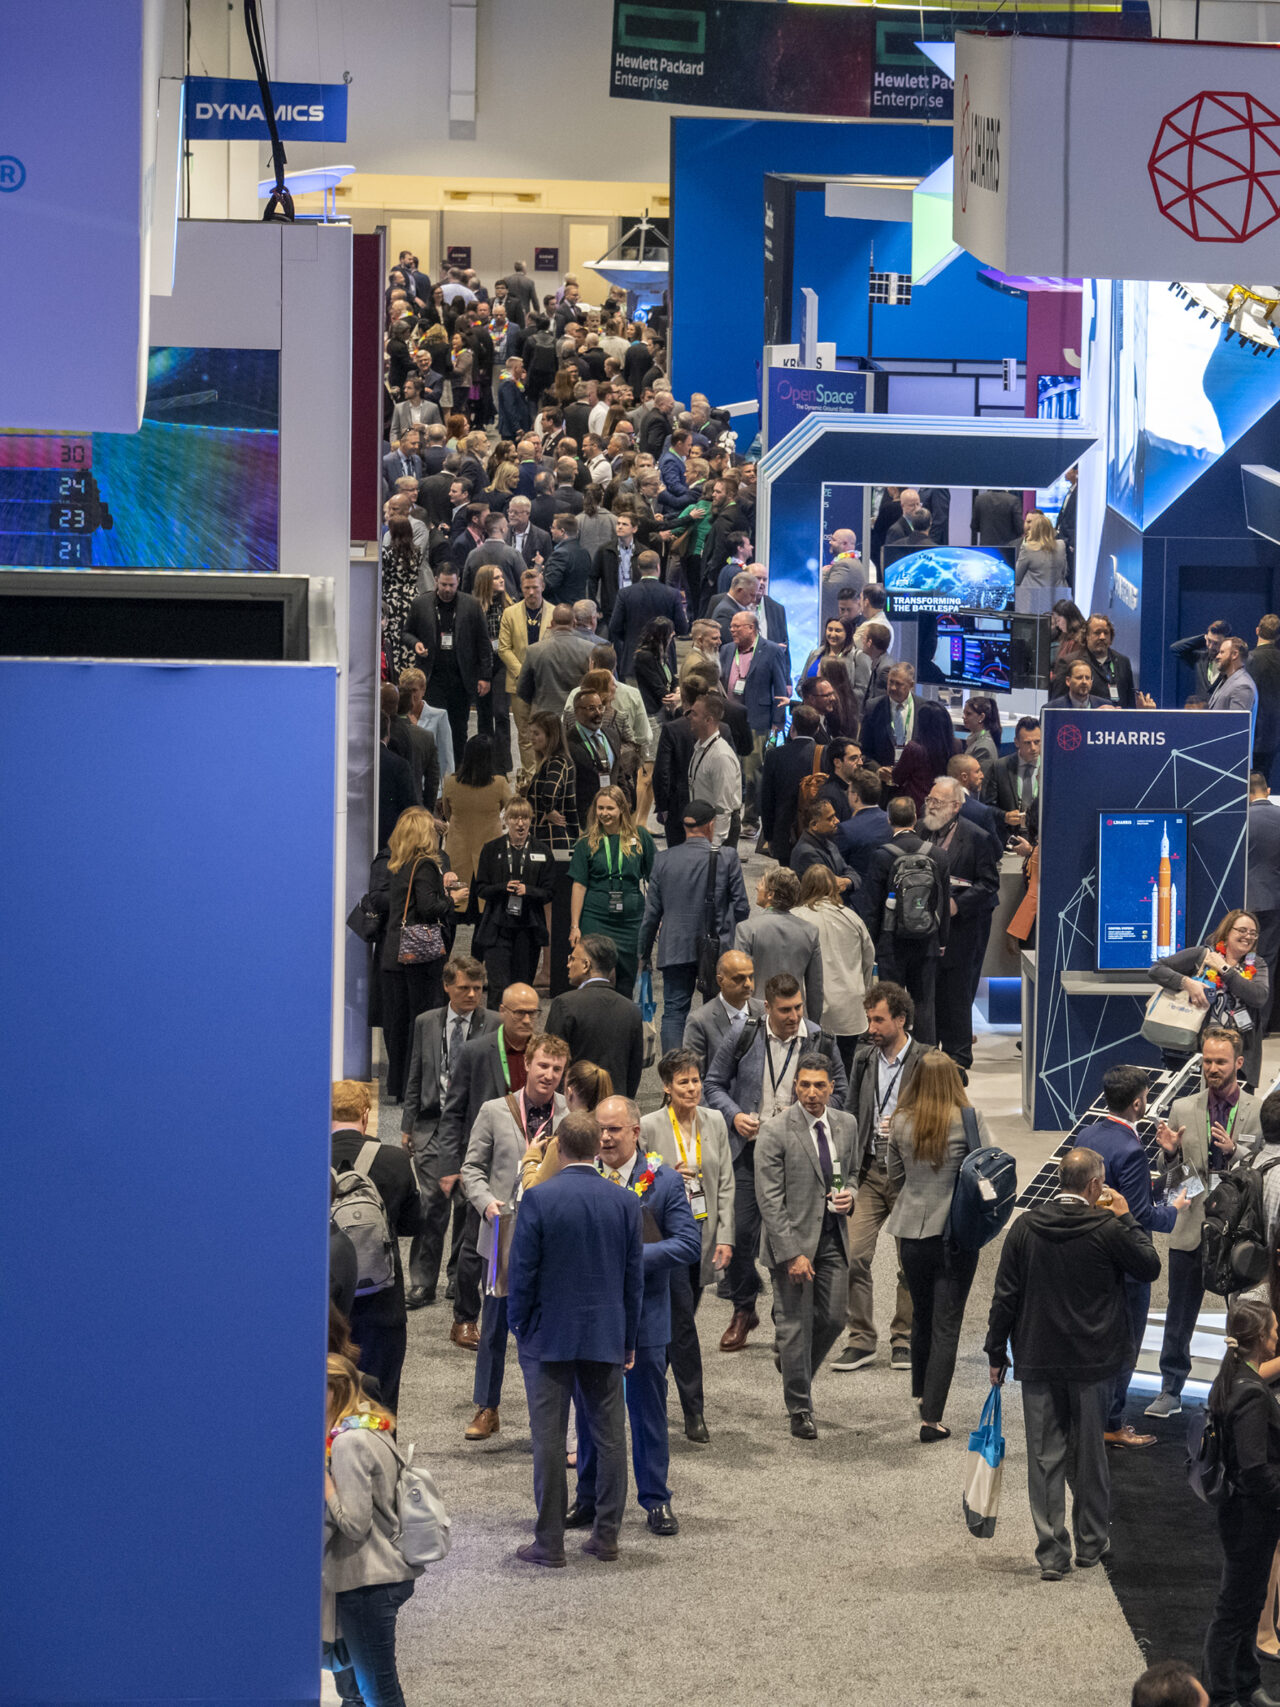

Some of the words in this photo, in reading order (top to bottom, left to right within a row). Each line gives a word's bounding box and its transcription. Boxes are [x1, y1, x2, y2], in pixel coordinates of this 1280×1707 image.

[615, 53, 659, 72] Hewlett
[660, 60, 705, 76] Packard
[614, 71, 669, 91] Enterprise
[873, 72, 929, 89] Hewlett
[873, 91, 944, 109] Enterprise
[777, 380, 855, 405] OpenSpace
[60, 445, 85, 463] 30
[59, 477, 85, 496] 24
[59, 509, 85, 528] 23
[59, 541, 81, 560] 21
[893, 596, 961, 605] TRANSFORMING
[893, 604, 911, 612] THE
[1086, 731, 1166, 745] L3HARRIS
